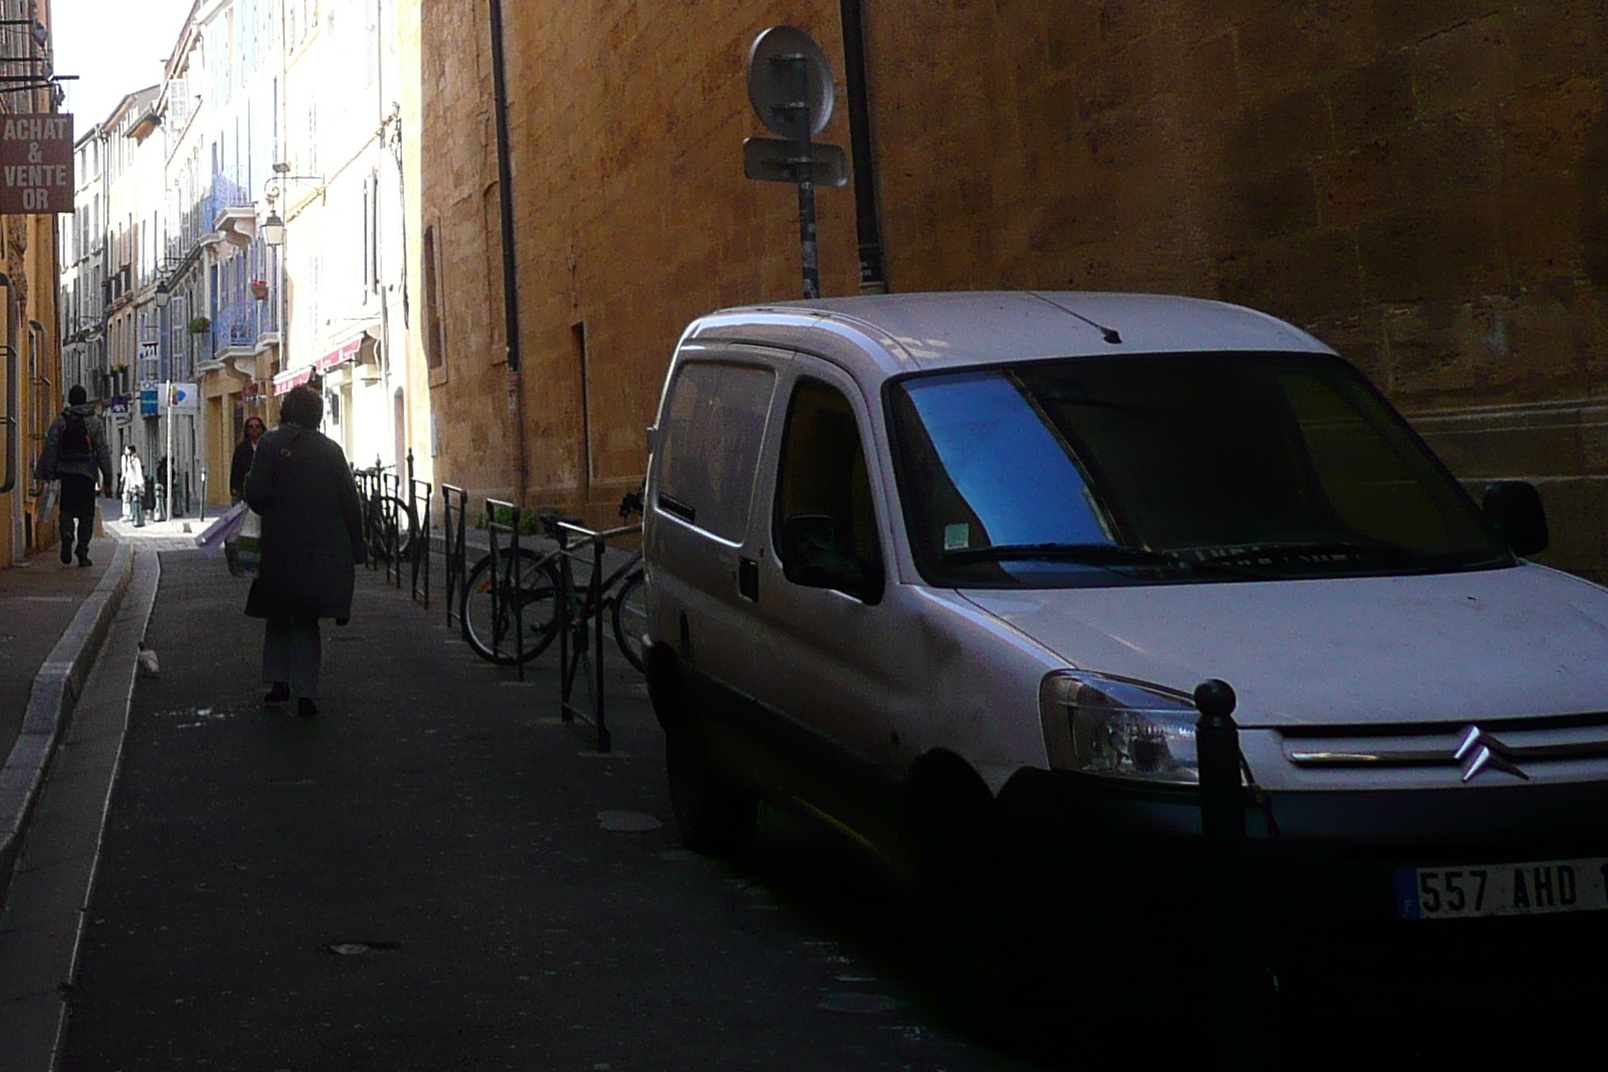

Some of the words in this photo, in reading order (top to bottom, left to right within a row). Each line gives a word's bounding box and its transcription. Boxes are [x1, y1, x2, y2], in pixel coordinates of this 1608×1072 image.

[3, 118, 68, 142] ACHAT
[28, 141, 43, 164] &
[3, 165, 68, 188] VENTE
[22, 188, 50, 211] OR
[1420, 869, 1488, 912] 557
[1513, 864, 1578, 908] AHD
